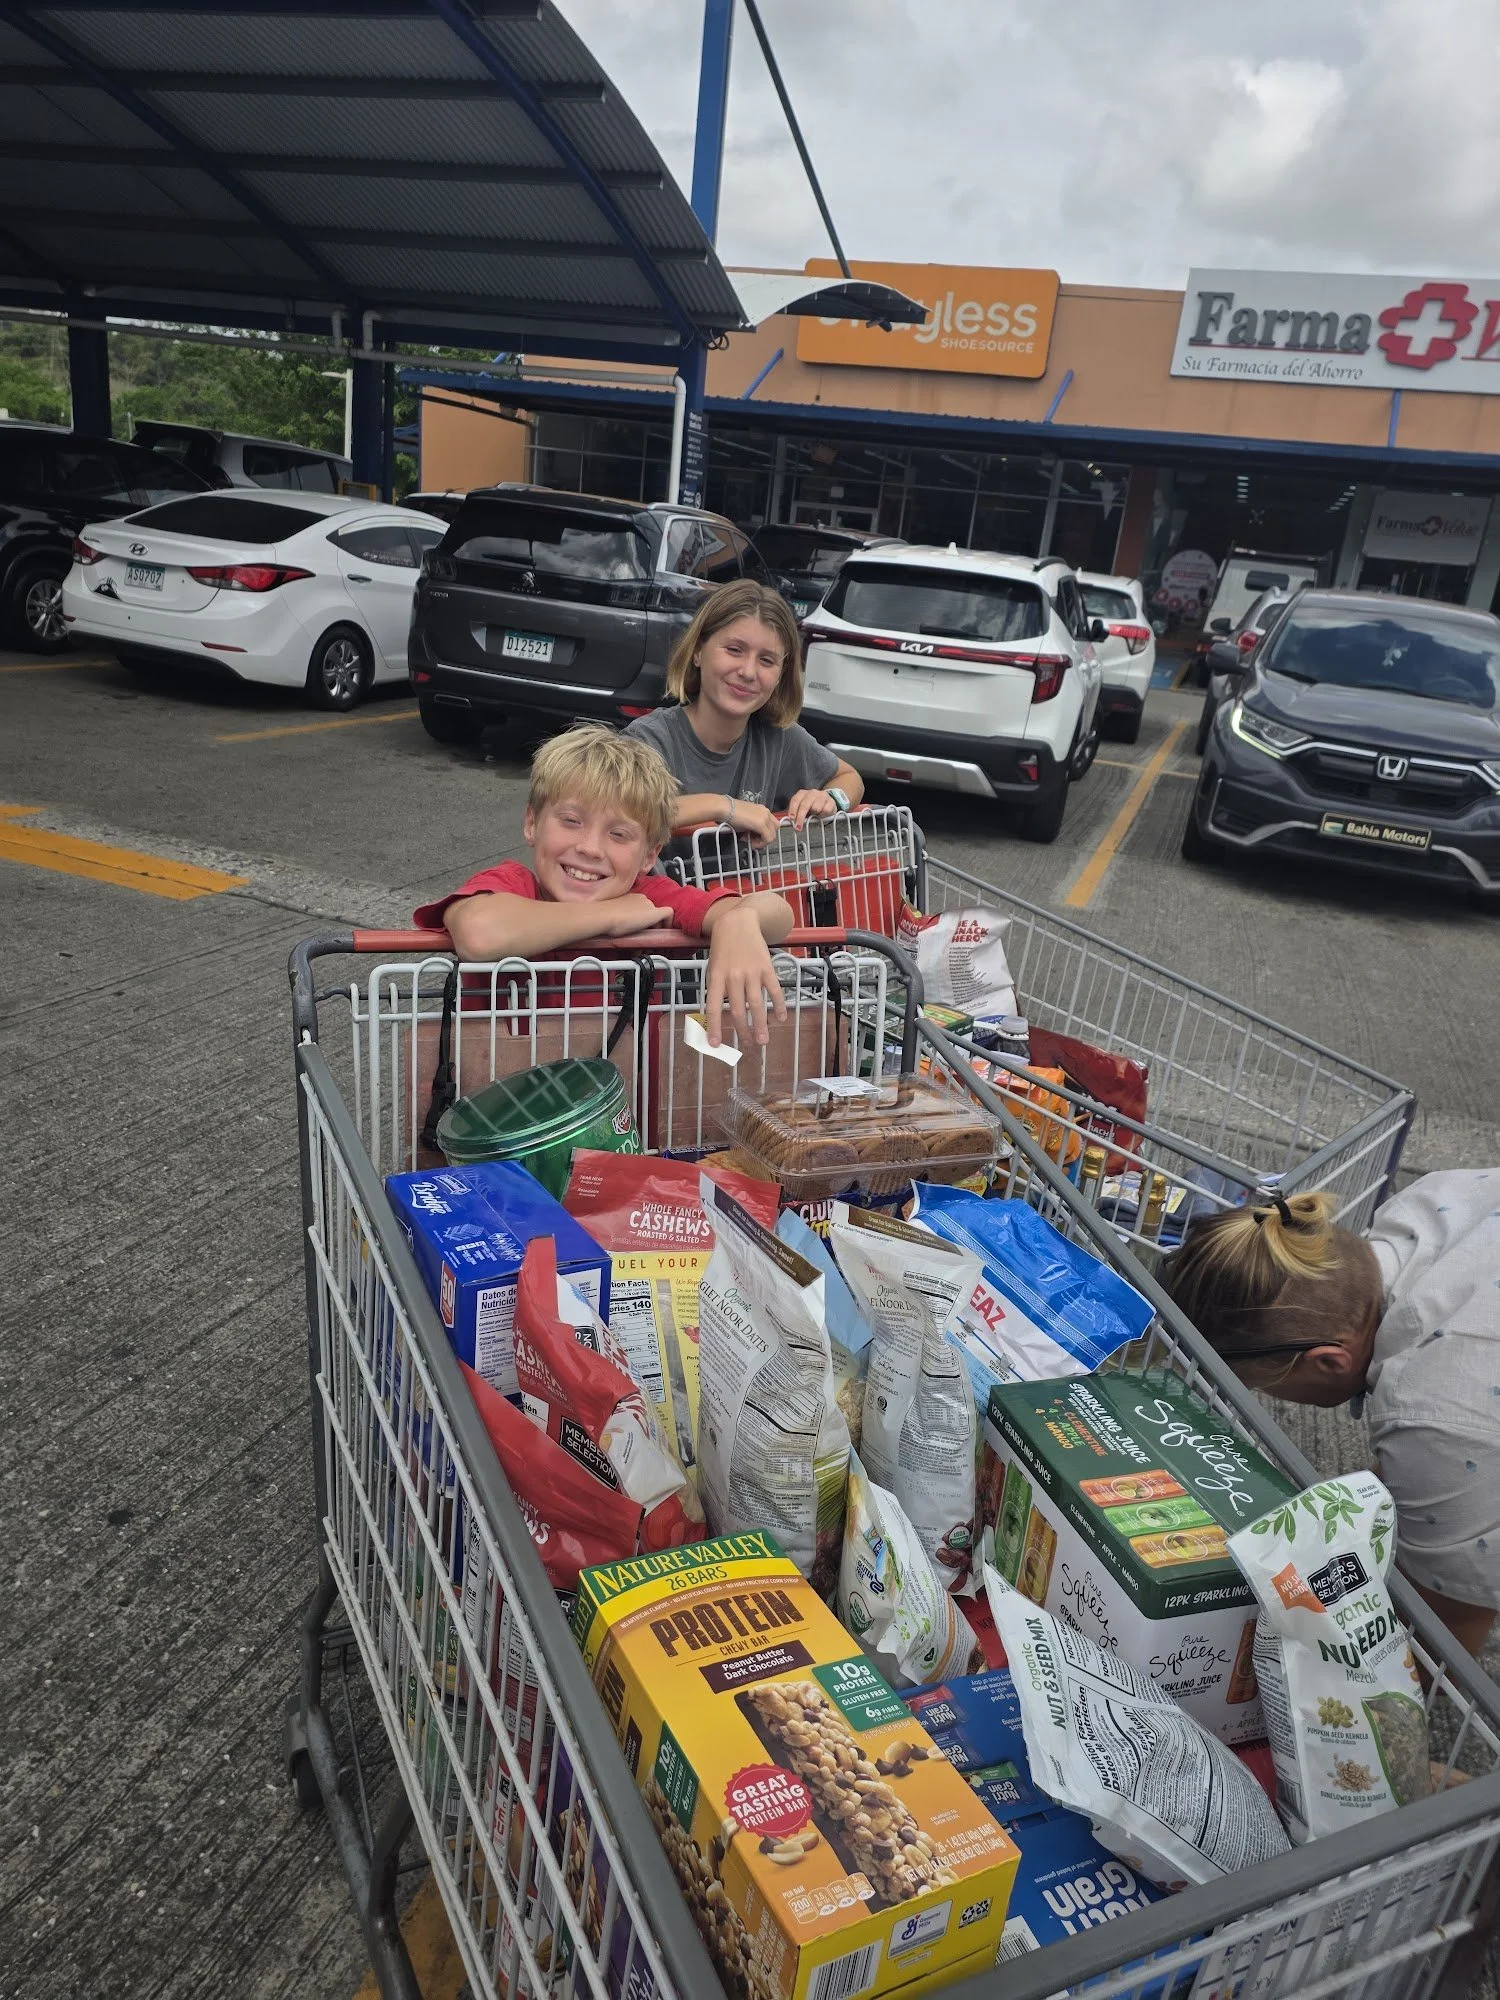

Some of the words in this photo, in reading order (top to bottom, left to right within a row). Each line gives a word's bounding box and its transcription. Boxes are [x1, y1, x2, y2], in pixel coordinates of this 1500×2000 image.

[852, 291, 1038, 344] yless
[1188, 291, 1373, 350] Farma
[940, 338, 1034, 353] SHOESOURCE
[1182, 356, 1201, 371] Su
[1207, 357, 1278, 374] Farmacia
[1283, 359, 1303, 376] del
[1309, 362, 1364, 380] Ahorro
[127, 566, 162, 585] AS0707
[506, 636, 549, 656] DI2521
[900, 641, 934, 655] KIA
[1382, 828, 1426, 846] Motors
[954, 927, 990, 936] SNACK
[971, 919, 979, 927] A
[642, 1202, 673, 1216] WHOLE
[674, 1206, 703, 1218] FANCY
[629, 1210, 712, 1238] CASHEWS
[637, 1230, 667, 1241] ROASTED
[675, 1235, 700, 1244] SALTED
[618, 1259, 647, 1269] UEL
[657, 1258, 698, 1268] YOUR
[441, 1271, 455, 1301] 50
[482, 1290, 506, 1301] Datos
[508, 1288, 517, 1296] de
[627, 1280, 649, 1288] Facts
[632, 1300, 652, 1310] 140
[724, 1288, 752, 1313] Organic
[879, 1298, 904, 1310] NOOR
[699, 1278, 720, 1302] GLET
[716, 1301, 746, 1329] NOOR
[741, 1324, 769, 1354] DATES
[1035, 1407, 1045, 1415] 4
[1045, 1421, 1075, 1449] MANGO
[1048, 1407, 1058, 1415] 4
[1059, 1421, 1086, 1447] APPLE
[1054, 1398, 1063, 1406] 4
[1064, 1411, 1109, 1457] CLEMENTINE
[1069, 1382, 1122, 1433] SPARKLING
[1116, 1435, 1152, 1464] JUICE
[564, 1423, 605, 1461] MEMBE
[1004, 1421, 1035, 1462] SPARKLING
[1033, 1459, 1052, 1485] JUICE
[1209, 1434, 1251, 1473] Pure
[566, 1436, 616, 1481] SELECTION
[1134, 1398, 1254, 1512] Squeeze
[1070, 1503, 1096, 1538] CLEMENTINE
[1101, 1543, 1117, 1564] APPLE
[1121, 1568, 1139, 1591] MANGO
[591, 1551, 691, 1600] NATURE
[685, 1532, 774, 1567] VALLEY
[666, 1574, 687, 1591] 26
[685, 1566, 728, 1584] BARS
[855, 1566, 865, 1582] FREE
[857, 1559, 875, 1581] GLUTEN
[1312, 1561, 1357, 1592] MEMER'S
[1165, 1594, 1190, 1609] 12PK
[1192, 1585, 1249, 1604] SPARKLING
[1281, 1579, 1293, 1594] NO
[1288, 1583, 1309, 1600] ADD
[1317, 1572, 1360, 1601] SELETION
[626, 1610, 651, 1625] ARTIFICIAL
[650, 1601, 670, 1614] FLAVORS
[679, 1590, 705, 1602] ARTIFICIAL
[704, 1585, 723, 1595] COLORS
[1334, 1592, 1382, 1630] ganic
[650, 1589, 804, 1658] PROTEIN
[1024, 1617, 1048, 1643] MIX
[1060, 1604, 1083, 1634] SPARK
[720, 1641, 750, 1656] CHEWY
[752, 1635, 770, 1647] BAR
[1064, 1637, 1076, 1660] 100%
[1181, 1634, 1210, 1648] Pure
[1317, 1632, 1361, 1668] NU
[722, 1654, 756, 1671] Peanut
[757, 1647, 786, 1663] Butter
[724, 1664, 748, 1681] Dark
[748, 1653, 794, 1674] Chocolate
[832, 1662, 871, 1681] 10g
[1021, 1642, 1042, 1692] Organic
[1034, 1643, 1057, 1679] SEED
[1100, 1653, 1110, 1677] 100%
[1149, 1645, 1231, 1679] Squeeze
[833, 1675, 877, 1693] PROTEIN
[1043, 1679, 1060, 1696] &
[1161, 1679, 1195, 1692] ARKLING
[1197, 1673, 1223, 1687] JUICE
[841, 1693, 870, 1706] GLUTEN
[871, 1688, 888, 1699] FREE
[865, 1706, 882, 1718] 6g
[882, 1704, 900, 1714] FIBER
[884, 1711, 904, 1720] SERVING
[926, 1704, 950, 1718] Grain
[931, 1710, 957, 1727] Nutri
[1046, 1699, 1067, 1730] NUT
[1072, 1700, 1089, 1740] Facts/
[1307, 1726, 1330, 1738] PUMPKIN
[658, 1739, 676, 1769] 10g
[1095, 1741, 1106, 1753] de
[665, 1750, 678, 1793] PROTEIN
[1083, 1742, 1112, 1789] Nutrition
[1103, 1755, 1121, 1791] Datos
[732, 1774, 789, 1803] GREAT
[987, 1780, 1015, 1794] Grain
[996, 1789, 1021, 1805] Nutri
[1320, 1790, 1352, 1801] SUNFLOWER
[732, 1783, 805, 1819] TASTING
[743, 1805, 787, 1828] PROTEIN
[787, 1797, 810, 1816] BAR!
[935, 1842, 947, 1854] 26
[960, 1833, 969, 1844] OZ
[978, 1822, 997, 1837] BARS
[903, 1869, 919, 1883] NET
[915, 1864, 928, 1878] WT
[950, 1852, 961, 1865] OZ
[782, 1891, 794, 1899] PER
[793, 1885, 806, 1895] BAR
[1042, 1861, 1137, 1918] Grain
[792, 1897, 811, 1913] 200
